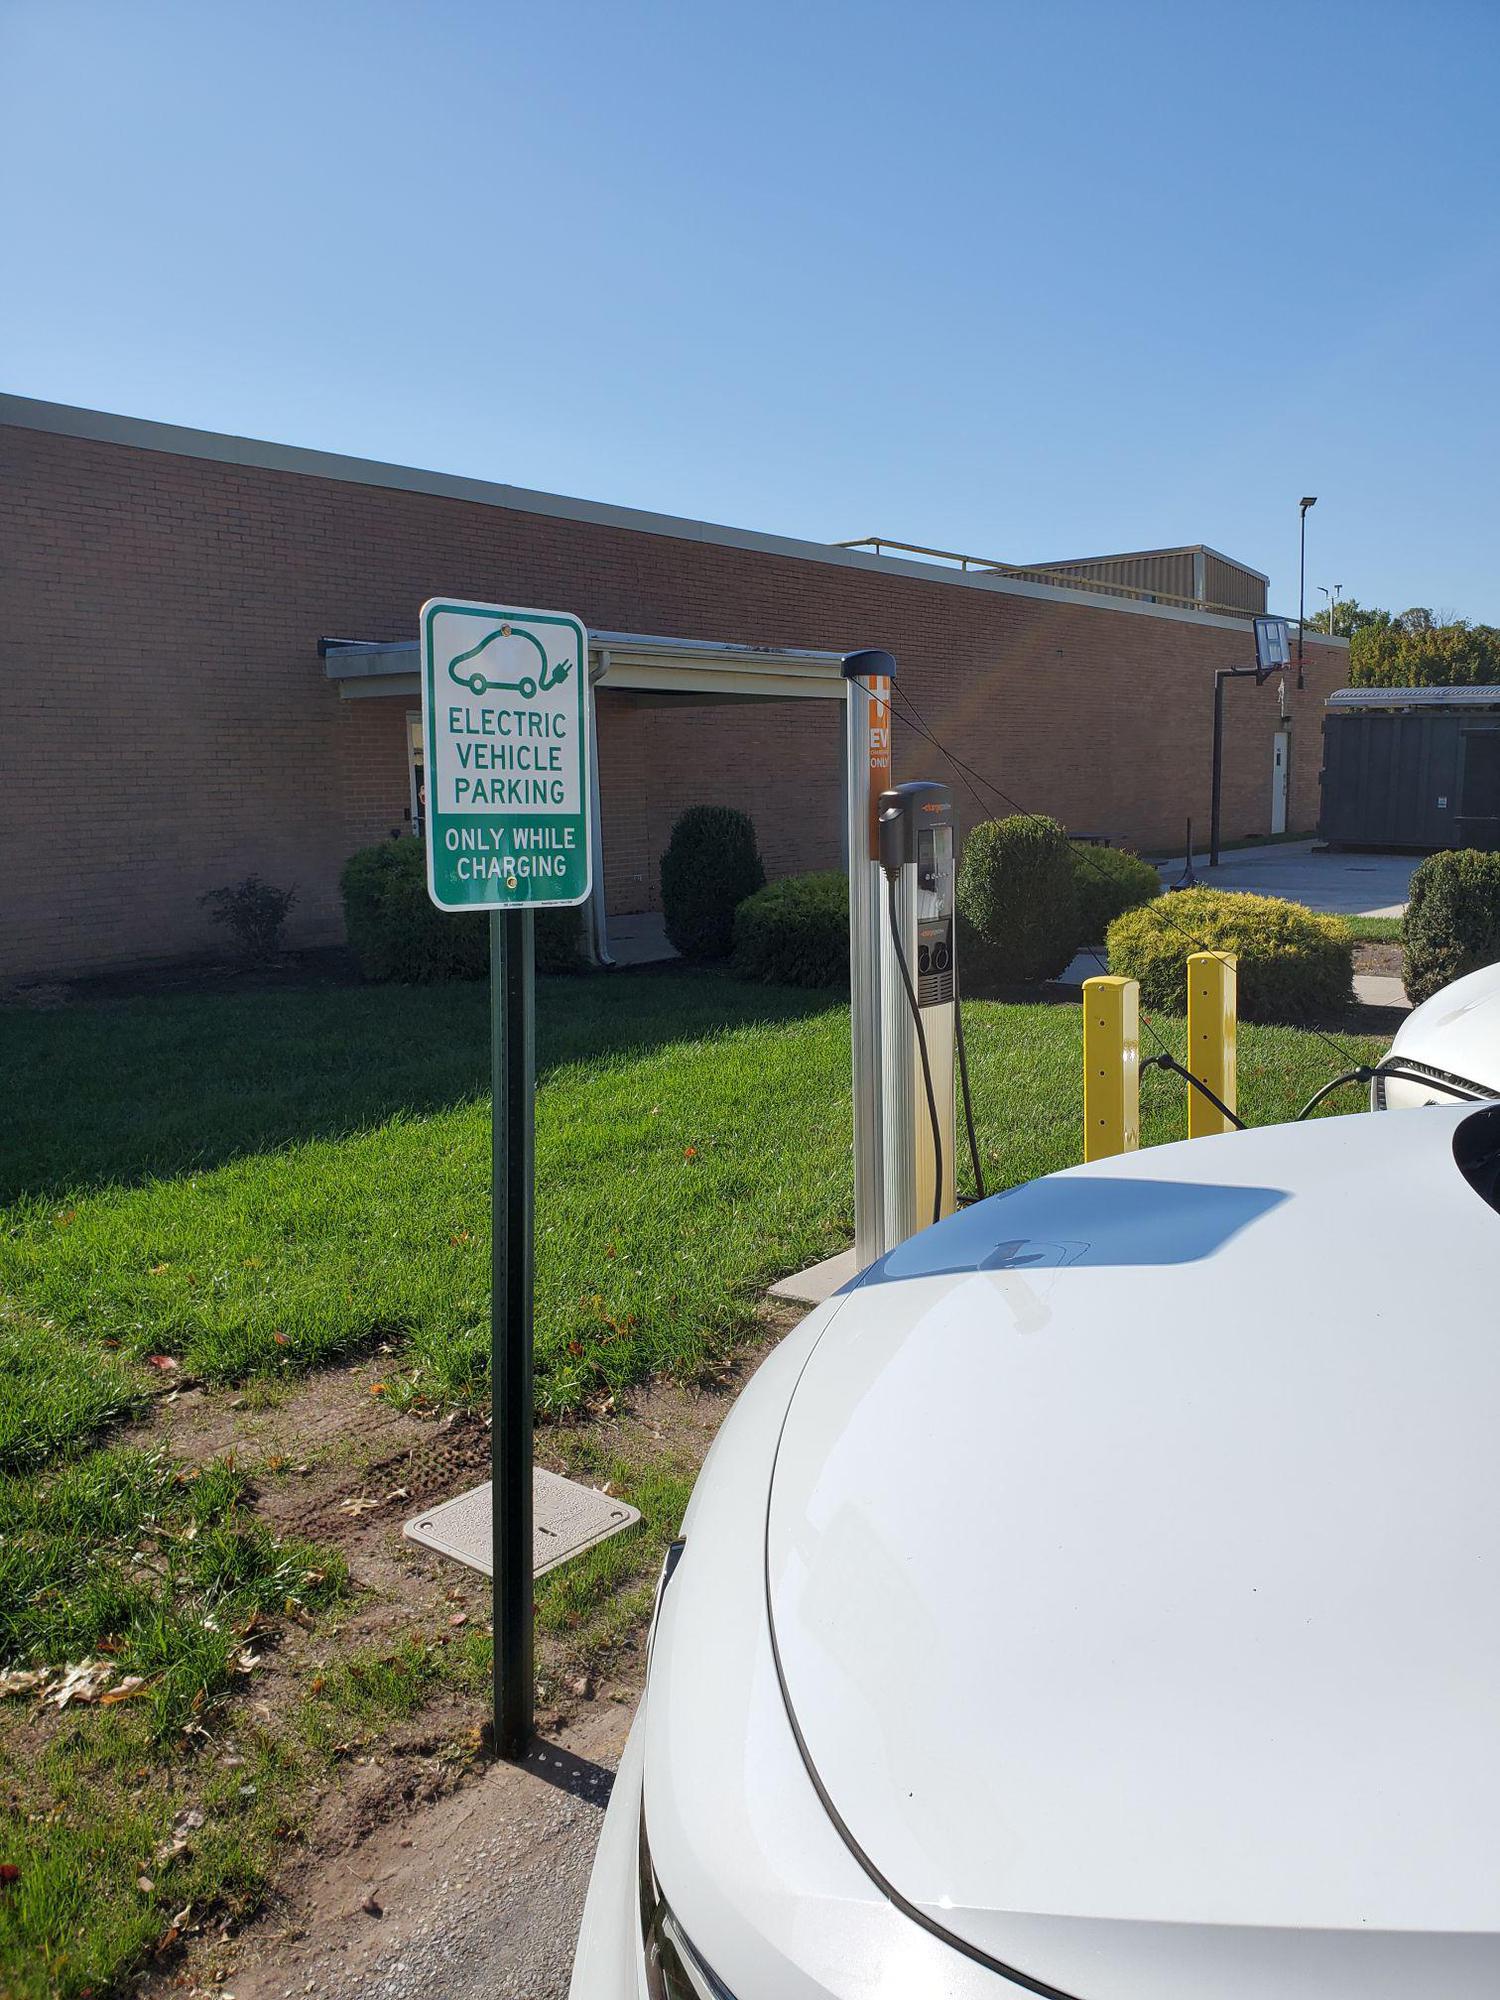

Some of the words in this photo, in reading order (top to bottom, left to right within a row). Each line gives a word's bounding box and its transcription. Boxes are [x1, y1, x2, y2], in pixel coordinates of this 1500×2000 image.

[449, 707, 566, 738] ELECTRIC
[870, 728, 888, 748] EV
[456, 743, 562, 771] VEHICLE
[455, 778, 564, 804] PARKING
[445, 828, 505, 851] ONLY
[512, 827, 576, 850] WHILE
[457, 855, 566, 879] CHARGING
